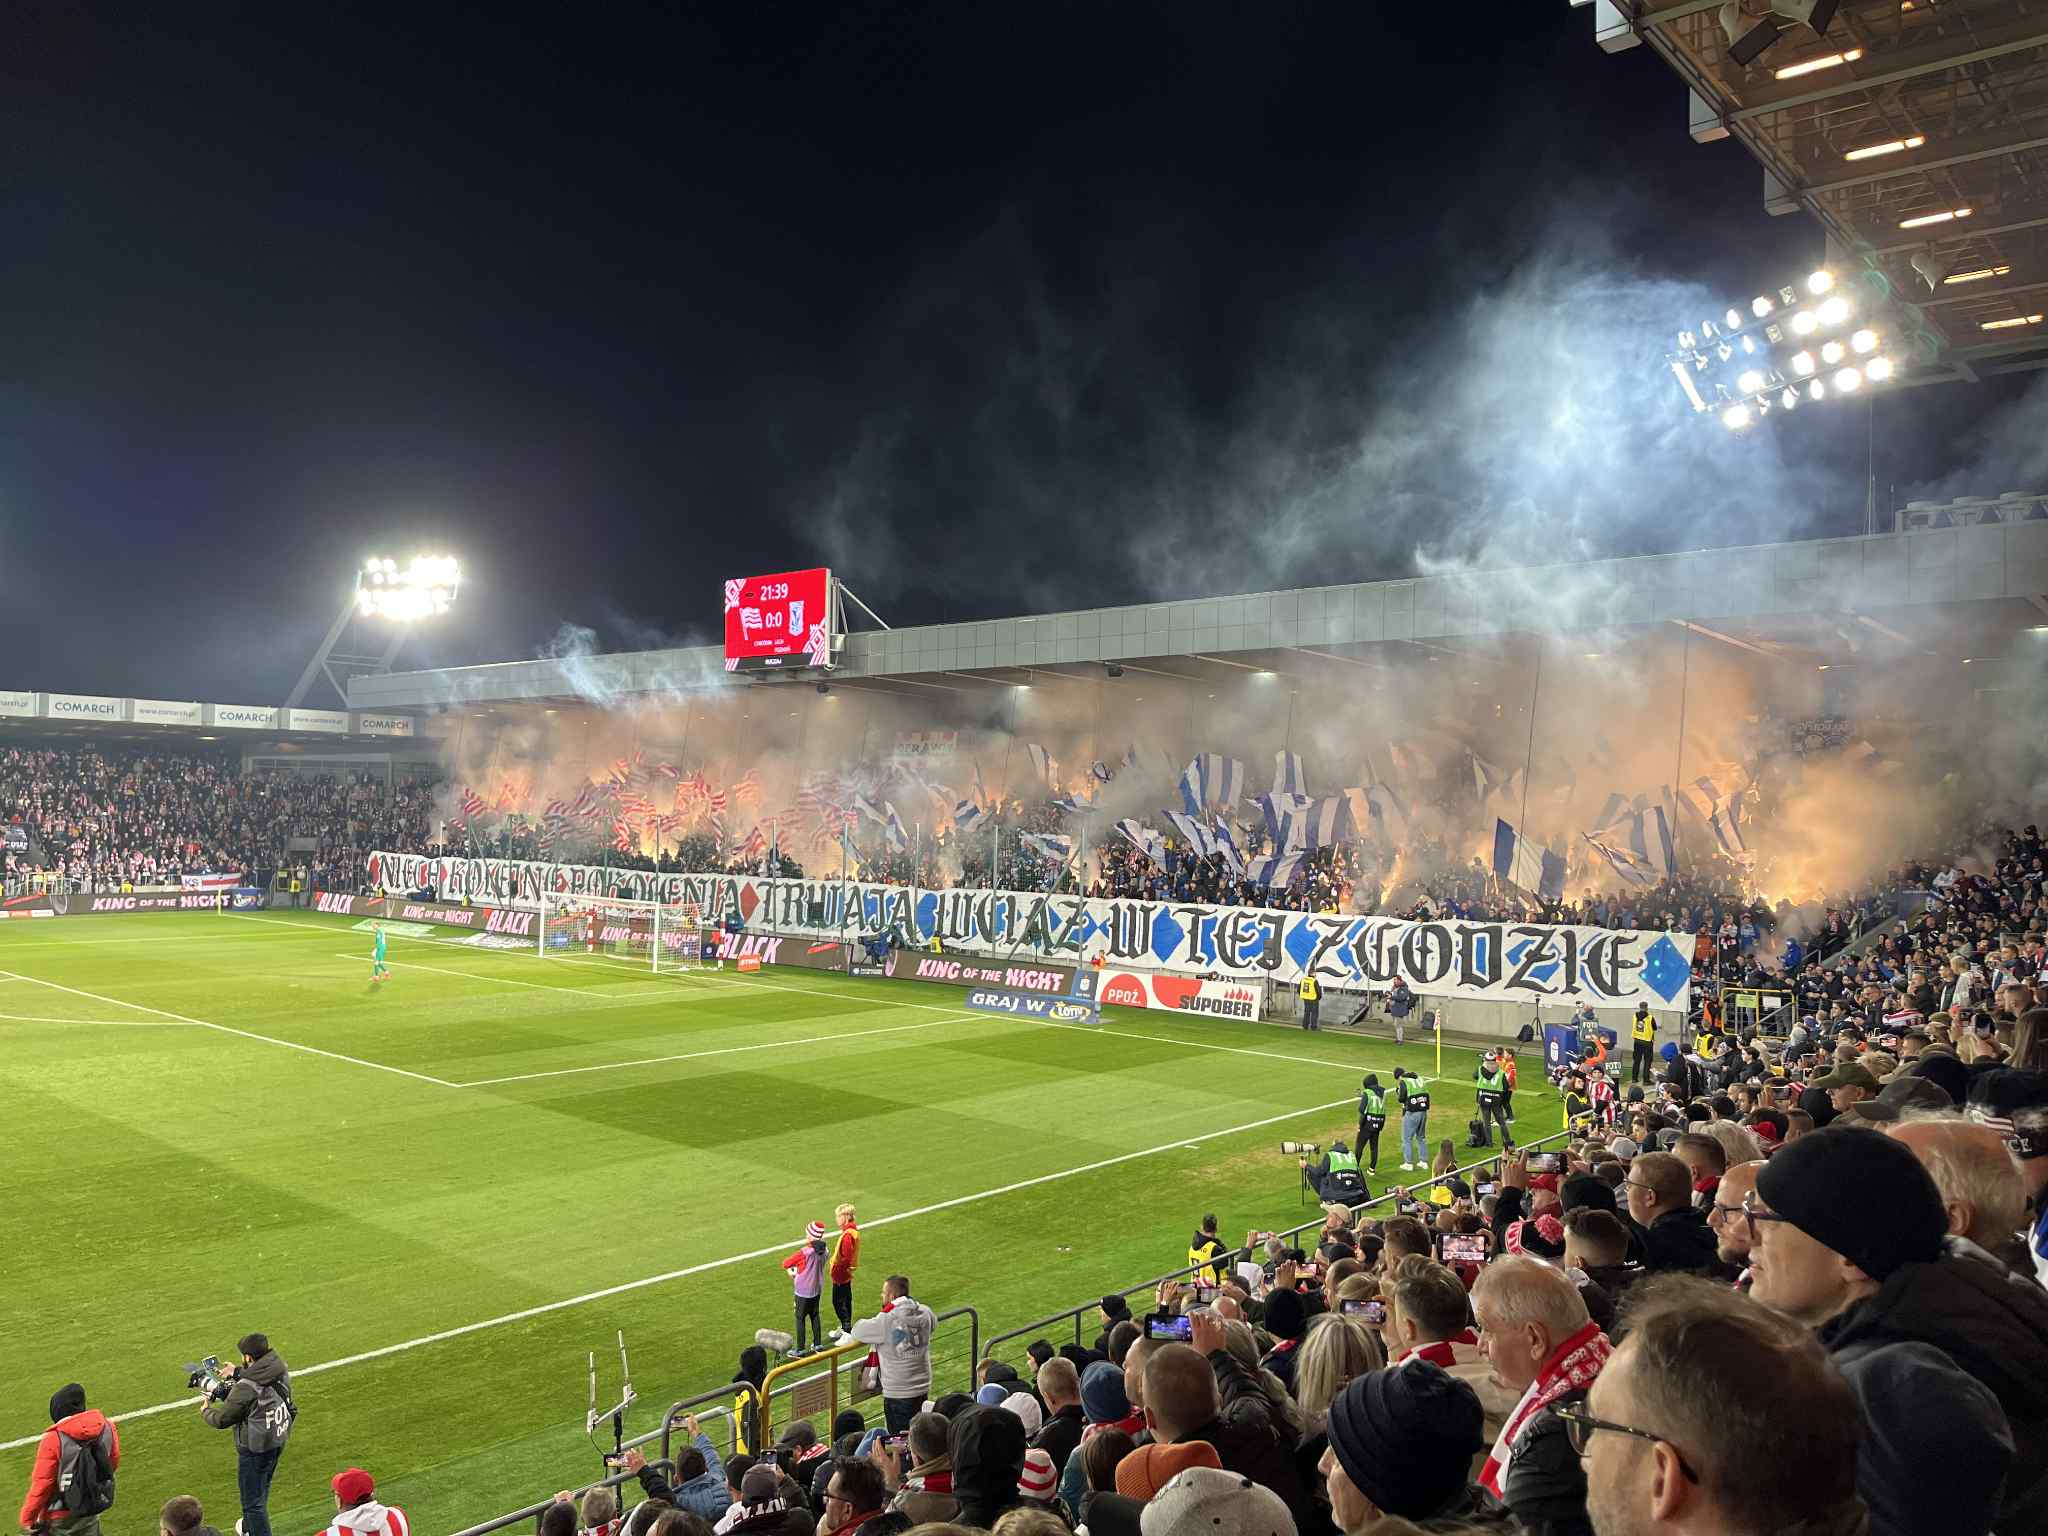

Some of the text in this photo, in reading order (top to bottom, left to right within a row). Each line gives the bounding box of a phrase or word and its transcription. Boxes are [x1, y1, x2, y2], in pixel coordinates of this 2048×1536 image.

[760, 583, 789, 601] 21:39
[765, 611, 783, 628] 0:0
[55, 702, 114, 714] COMARCH
[219, 711, 273, 723] COMARCH
[362, 719, 409, 730] COMARCH
[92, 897, 136, 911] KING
[155, 898, 176, 908] THE
[180, 895, 231, 909] NIGHT
[317, 892, 355, 914] BLACK
[401, 904, 425, 919] KING
[445, 910, 475, 925] NIGHT
[486, 911, 534, 936] BLACK
[716, 932, 785, 964] BLACK
[1106, 902, 1156, 959] W
[1171, 906, 1287, 970] TEJ
[1309, 918, 1644, 998] ZGODZIE
[916, 958, 1065, 992] KING OF THE NIGHT
[972, 992, 1046, 1013] GRAJ W
[1108, 988, 1141, 1005] PPOŻ.
[1179, 994, 1253, 1018] SUPOBER
[265, 1402, 288, 1430] FOT
